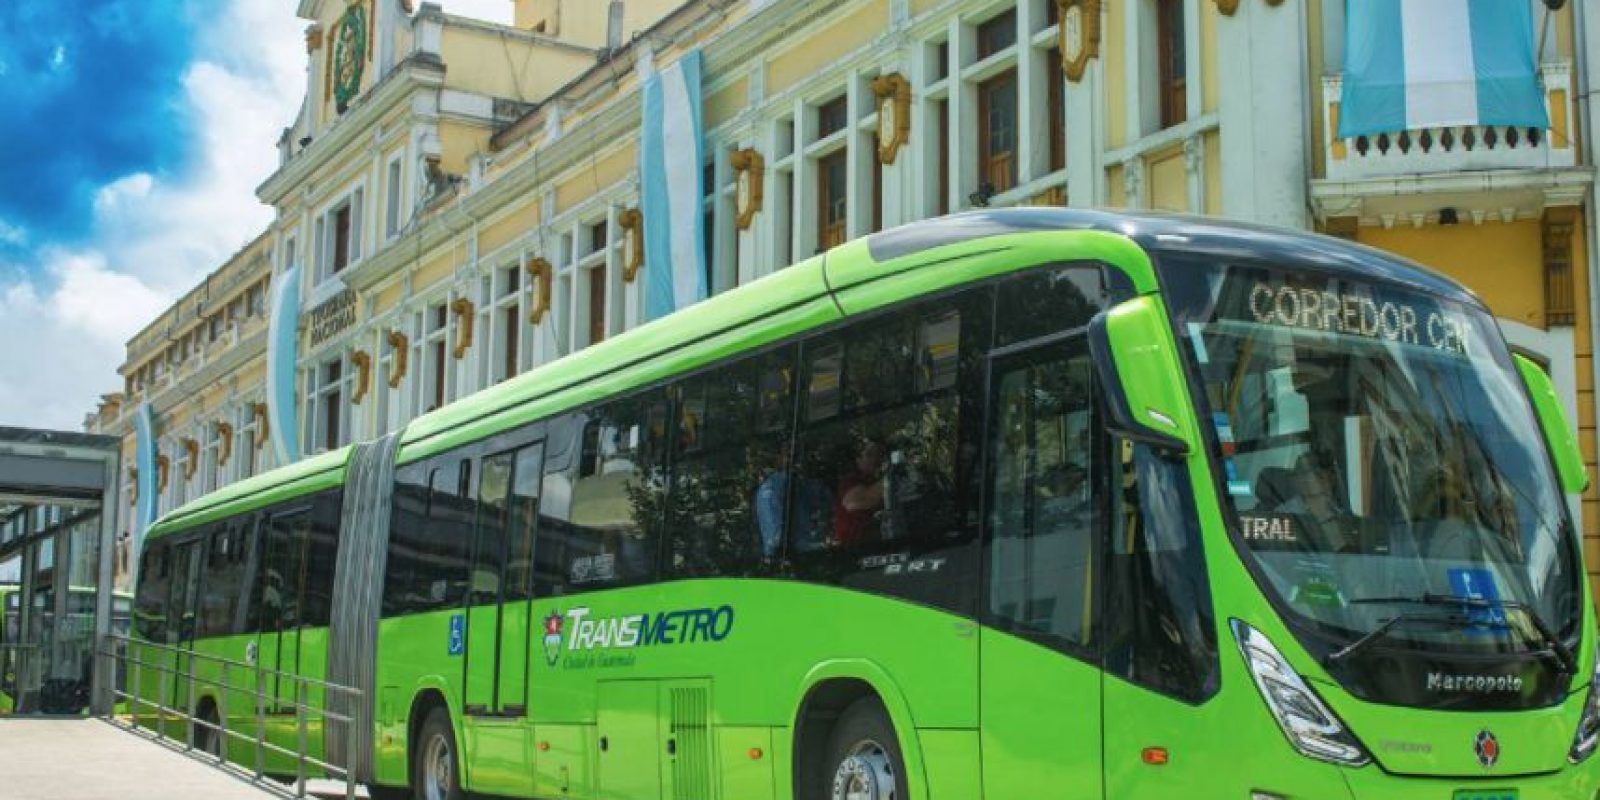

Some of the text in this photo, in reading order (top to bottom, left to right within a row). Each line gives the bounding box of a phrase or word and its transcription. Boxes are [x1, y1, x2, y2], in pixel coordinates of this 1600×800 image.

[1251, 284, 1418, 345] CORREDOR
[1240, 516, 1297, 541] TRAL
[1427, 672, 1523, 694] Marcopolo
